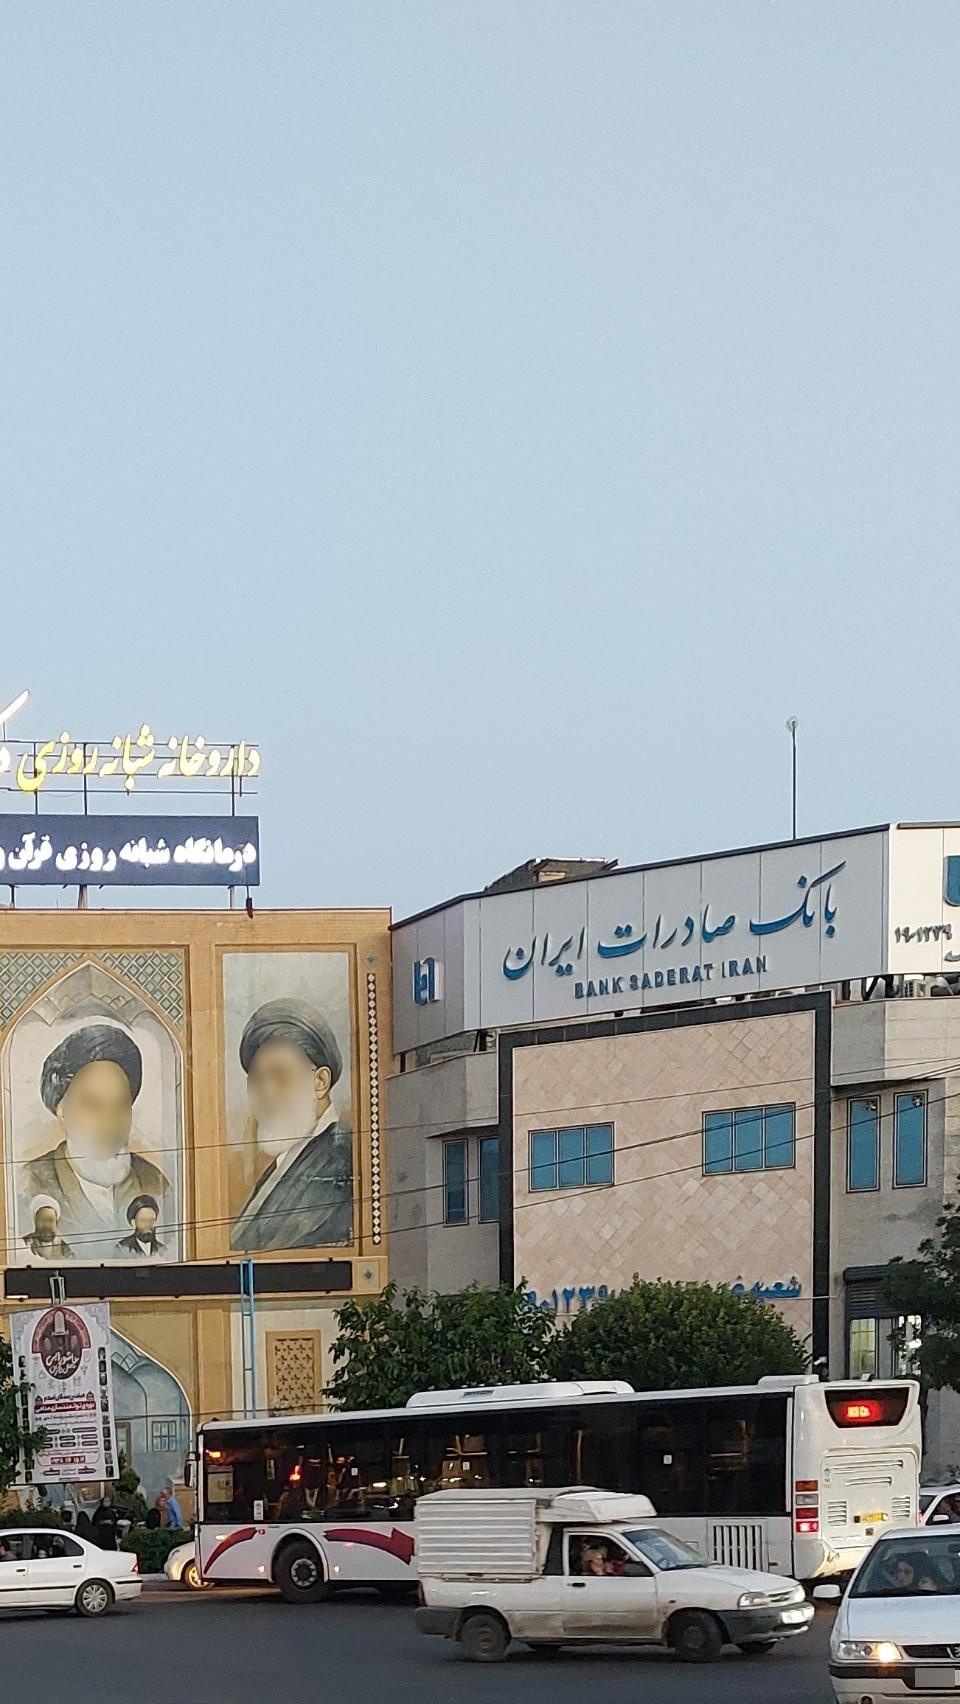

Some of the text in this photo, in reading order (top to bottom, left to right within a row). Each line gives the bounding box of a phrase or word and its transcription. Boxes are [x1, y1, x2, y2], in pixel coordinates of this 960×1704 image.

[16, 731, 99, 792] روزی
[98, 723, 156, 790] شبانه
[157, 734, 261, 779] داروخانه
[8, 832, 53, 870] قرآن
[55, 842, 117, 872] روزی
[119, 836, 170, 868] شبانه
[173, 836, 257, 872] درمانگاه
[502, 860, 847, 981] بانک صادرات ایران
[574, 955, 768, 999] BANK SADERAT IRAN
